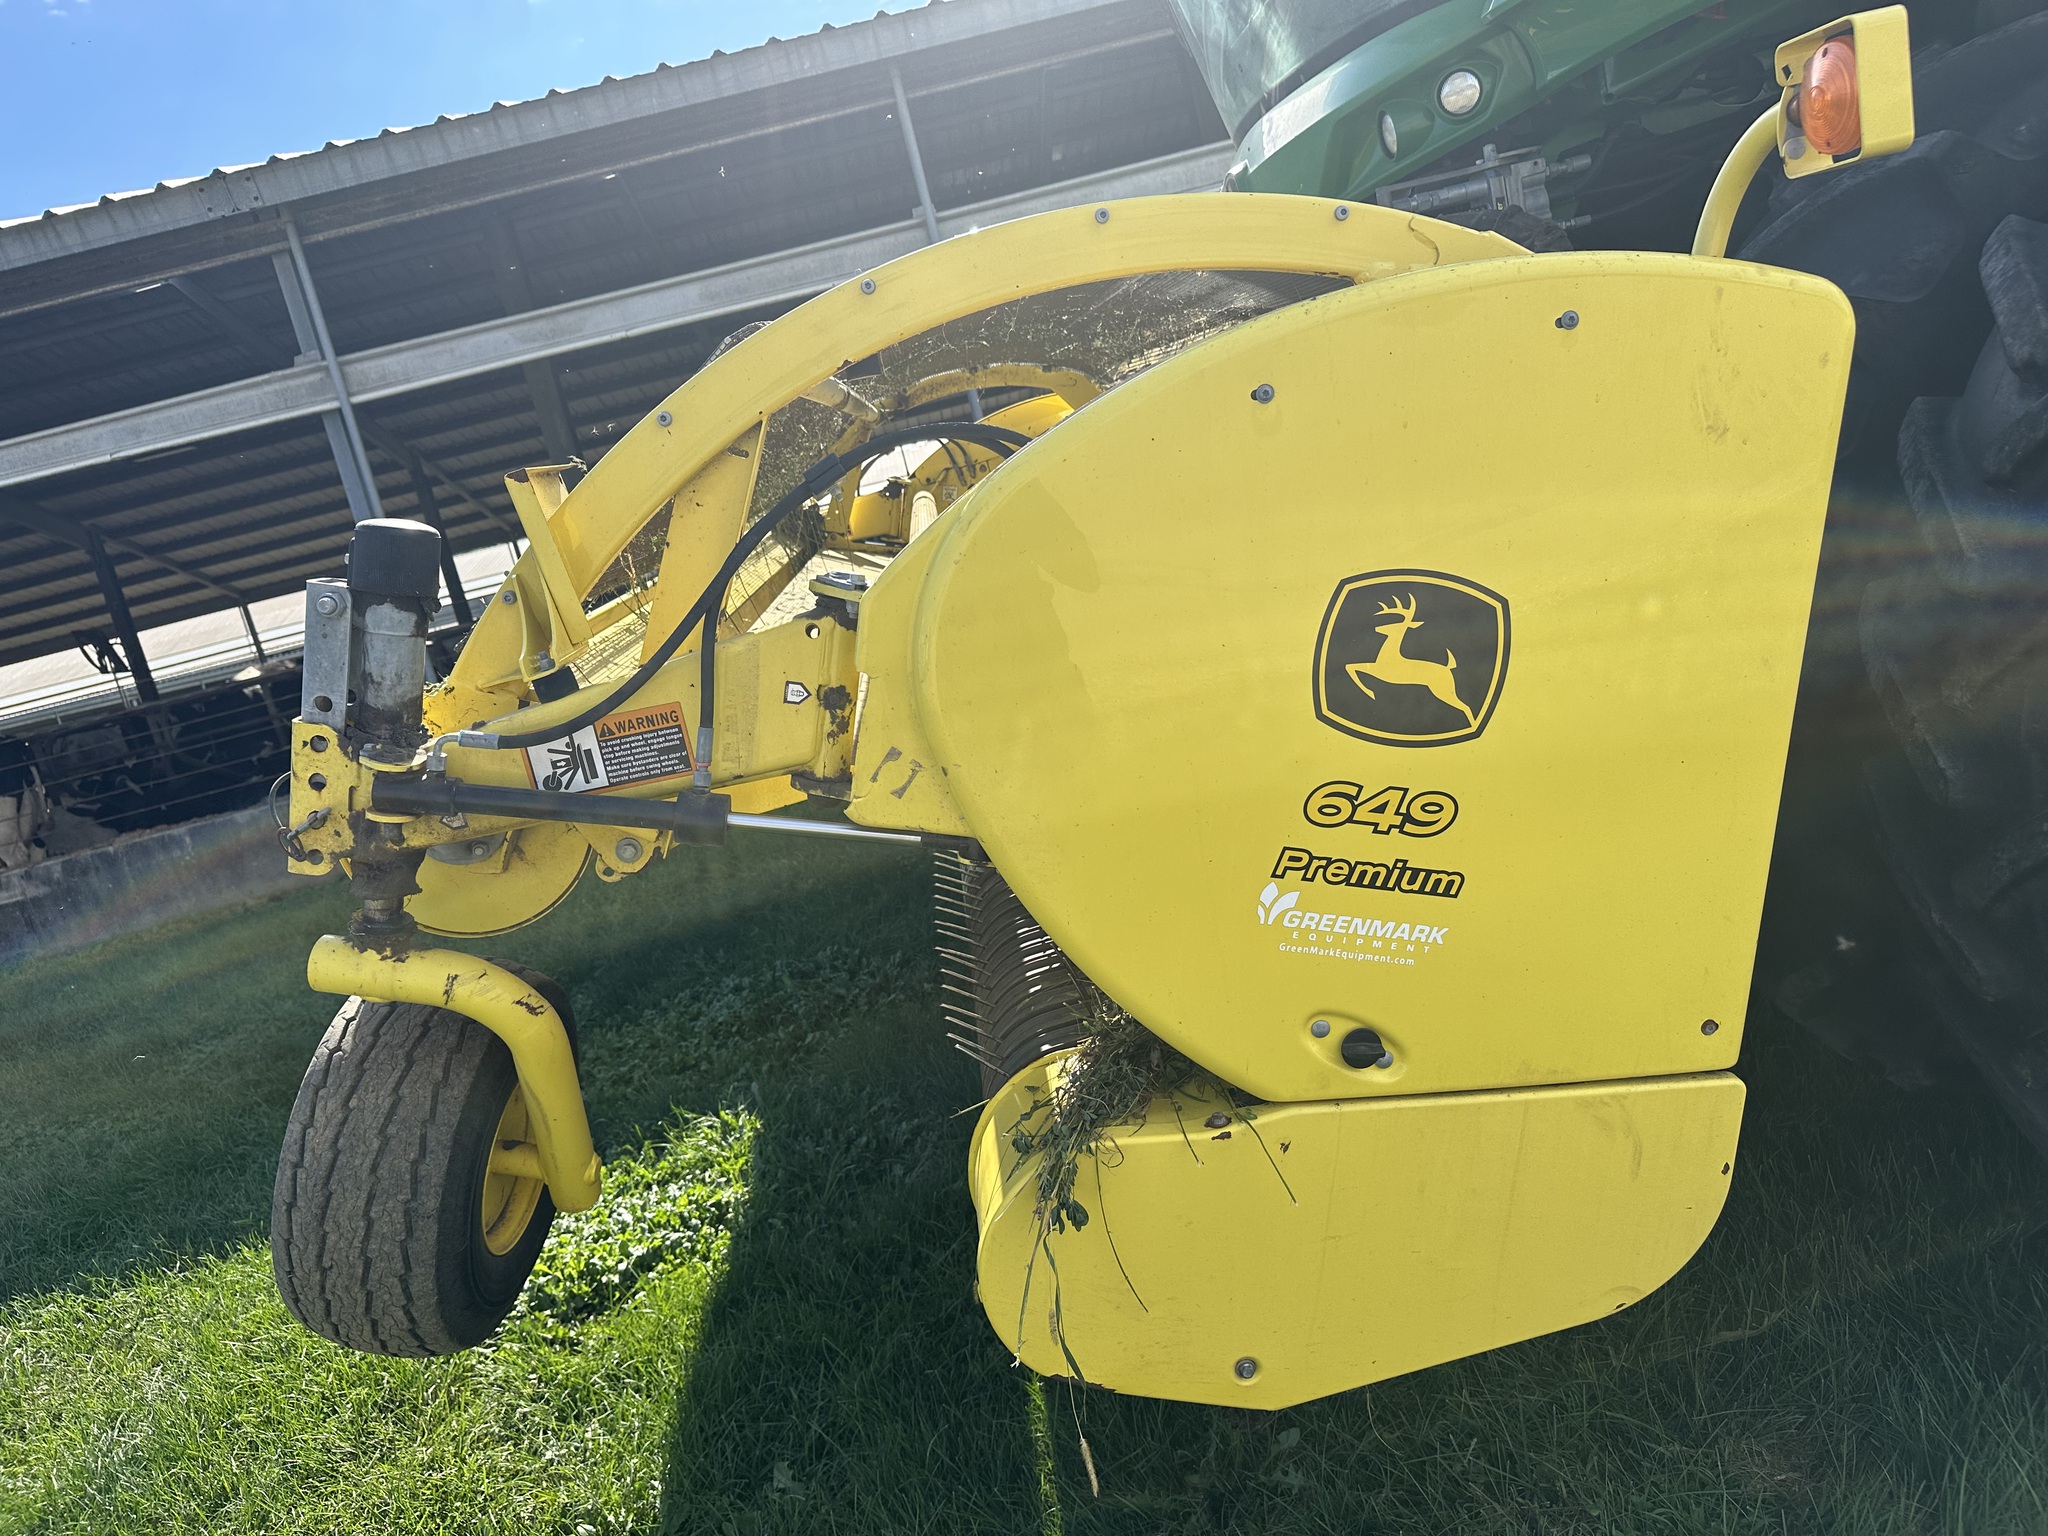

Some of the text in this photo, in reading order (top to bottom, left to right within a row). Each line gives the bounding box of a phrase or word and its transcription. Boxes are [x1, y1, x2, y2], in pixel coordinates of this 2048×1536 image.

[614, 710, 679, 734] WARNING
[621, 735, 642, 743] crushing
[1303, 780, 1459, 838] 649
[1270, 846, 1466, 898] Premium
[1283, 910, 1449, 944] GREENMARK
[1279, 942, 1415, 966] GreenMarkEquipment.com
[1292, 931, 1430, 954] EQUIPMENT
